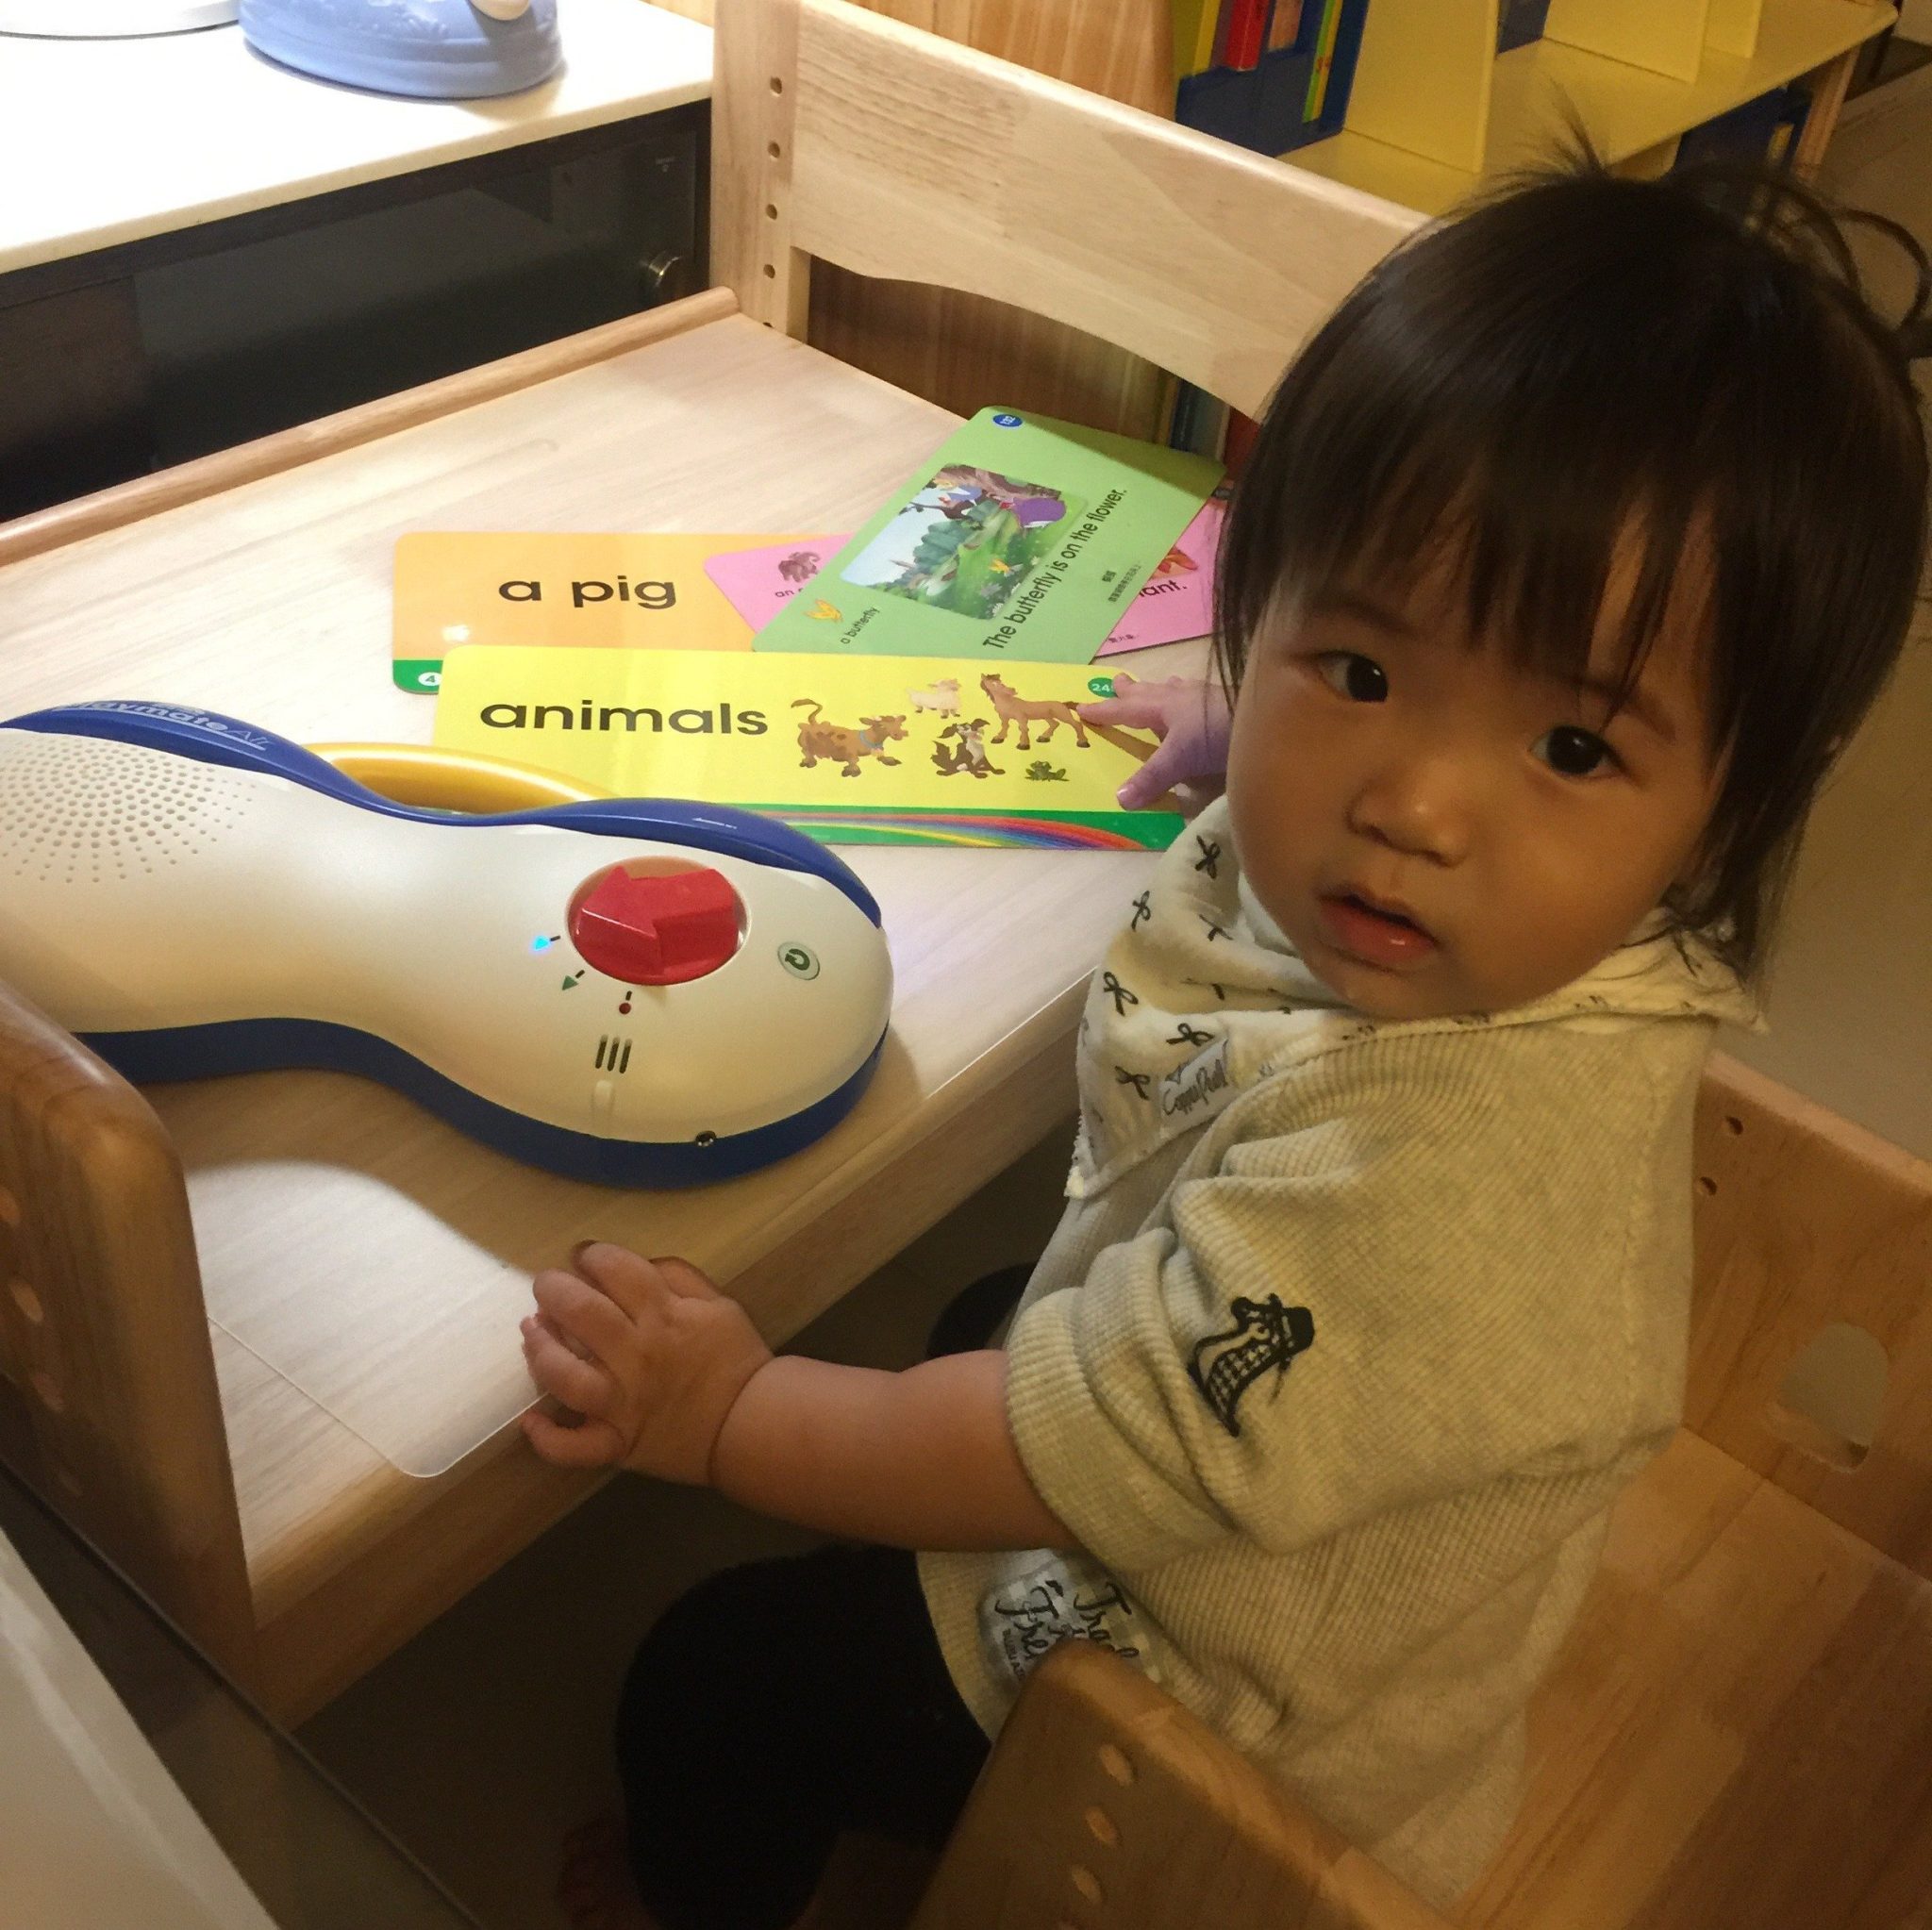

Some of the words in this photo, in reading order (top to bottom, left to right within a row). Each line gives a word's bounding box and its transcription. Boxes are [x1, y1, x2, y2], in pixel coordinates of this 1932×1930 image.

[1085, 489, 1128, 523] flower.
[1069, 522, 1099, 542] the
[1060, 542, 1084, 559] on
[1045, 559, 1069, 573] is
[497, 579, 541, 602] a
[571, 574, 677, 610] pig
[774, 589, 794, 598] an
[1003, 572, 1063, 624] butterfly
[844, 607, 881, 638] butterfly
[982, 624, 1017, 649] The
[425, 674, 436, 684] 4
[1091, 682, 1111, 693] 24
[479, 699, 769, 736] animals
